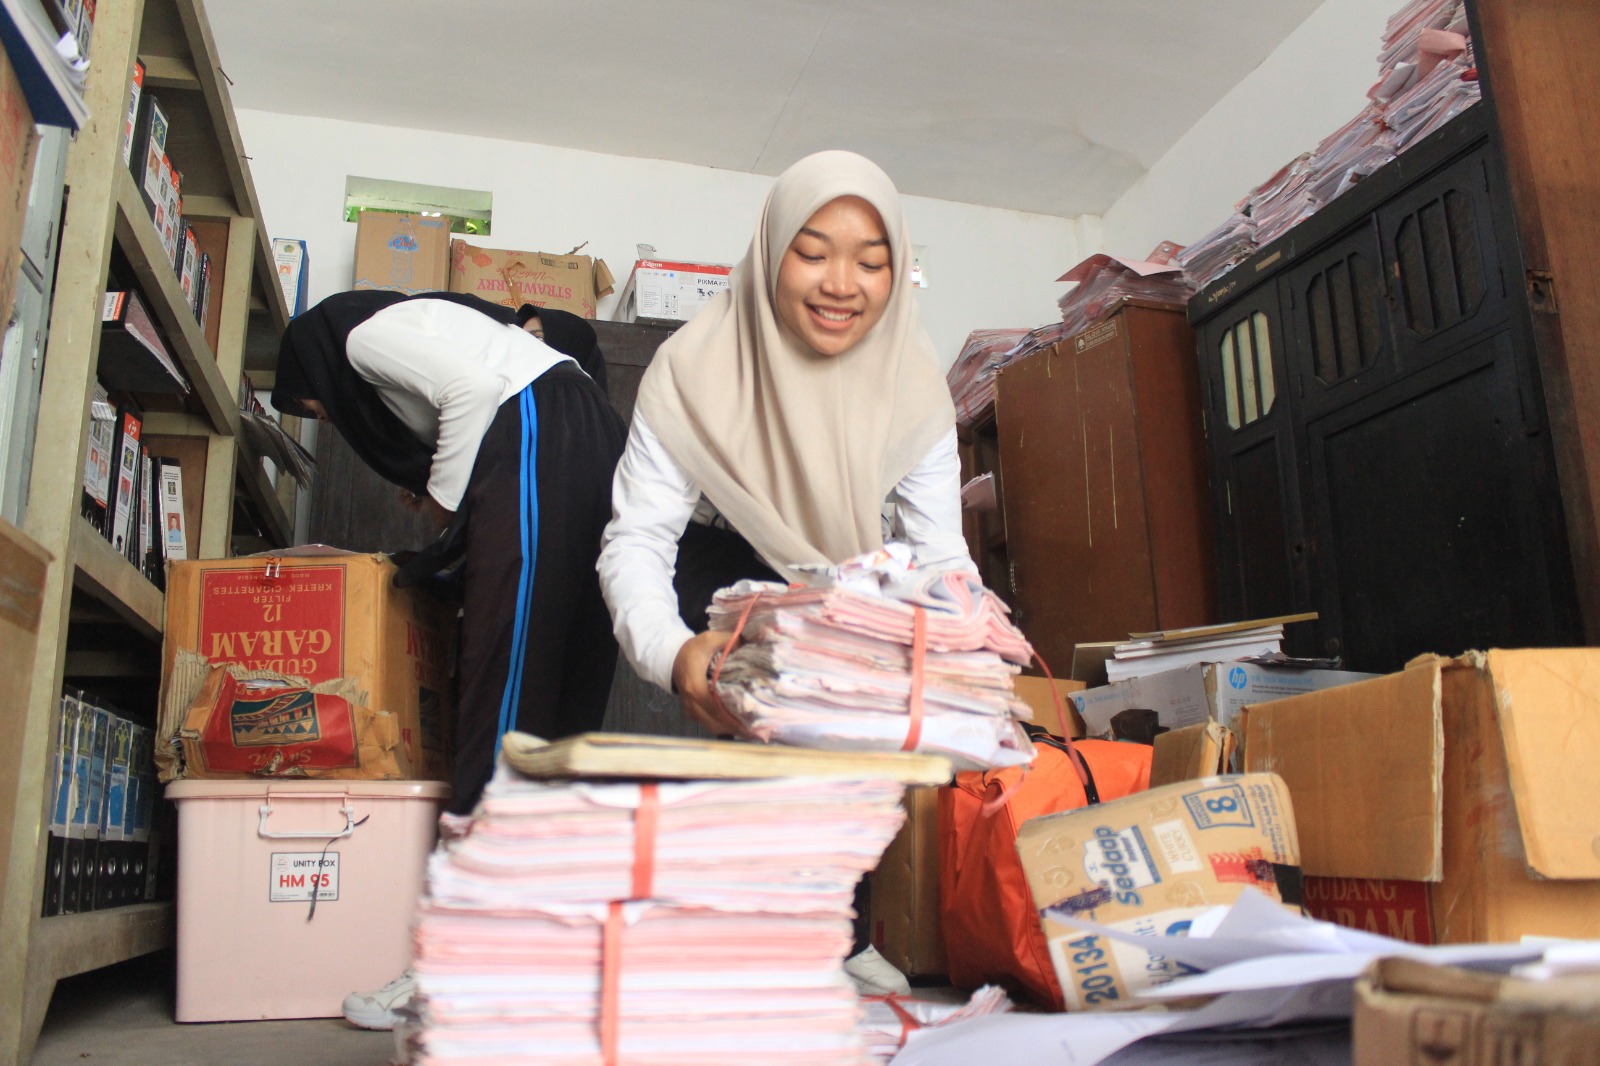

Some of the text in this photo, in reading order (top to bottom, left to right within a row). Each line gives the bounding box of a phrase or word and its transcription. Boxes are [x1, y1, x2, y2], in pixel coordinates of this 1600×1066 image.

[642, 261, 663, 269] Canon
[477, 278, 572, 299] STRAWRRY
[213, 583, 332, 595] KRETEK CIGARETTES
[253, 594, 292, 603] FILTER
[262, 604, 282, 623] 12
[211, 630, 331, 658] GARAM
[1231, 667, 1247, 690] hp
[1205, 795, 1238, 814] 8
[1160, 832, 1181, 864] WHITE
[1171, 830, 1195, 862] CURRY
[293, 860, 316, 868] UNITY
[1094, 825, 1144, 908] Sedaap
[279, 873, 330, 888] HM 95
[1304, 877, 1398, 902] GUDANG
[1320, 907, 1417, 944] RAM
[1069, 935, 1120, 1005] 20134
